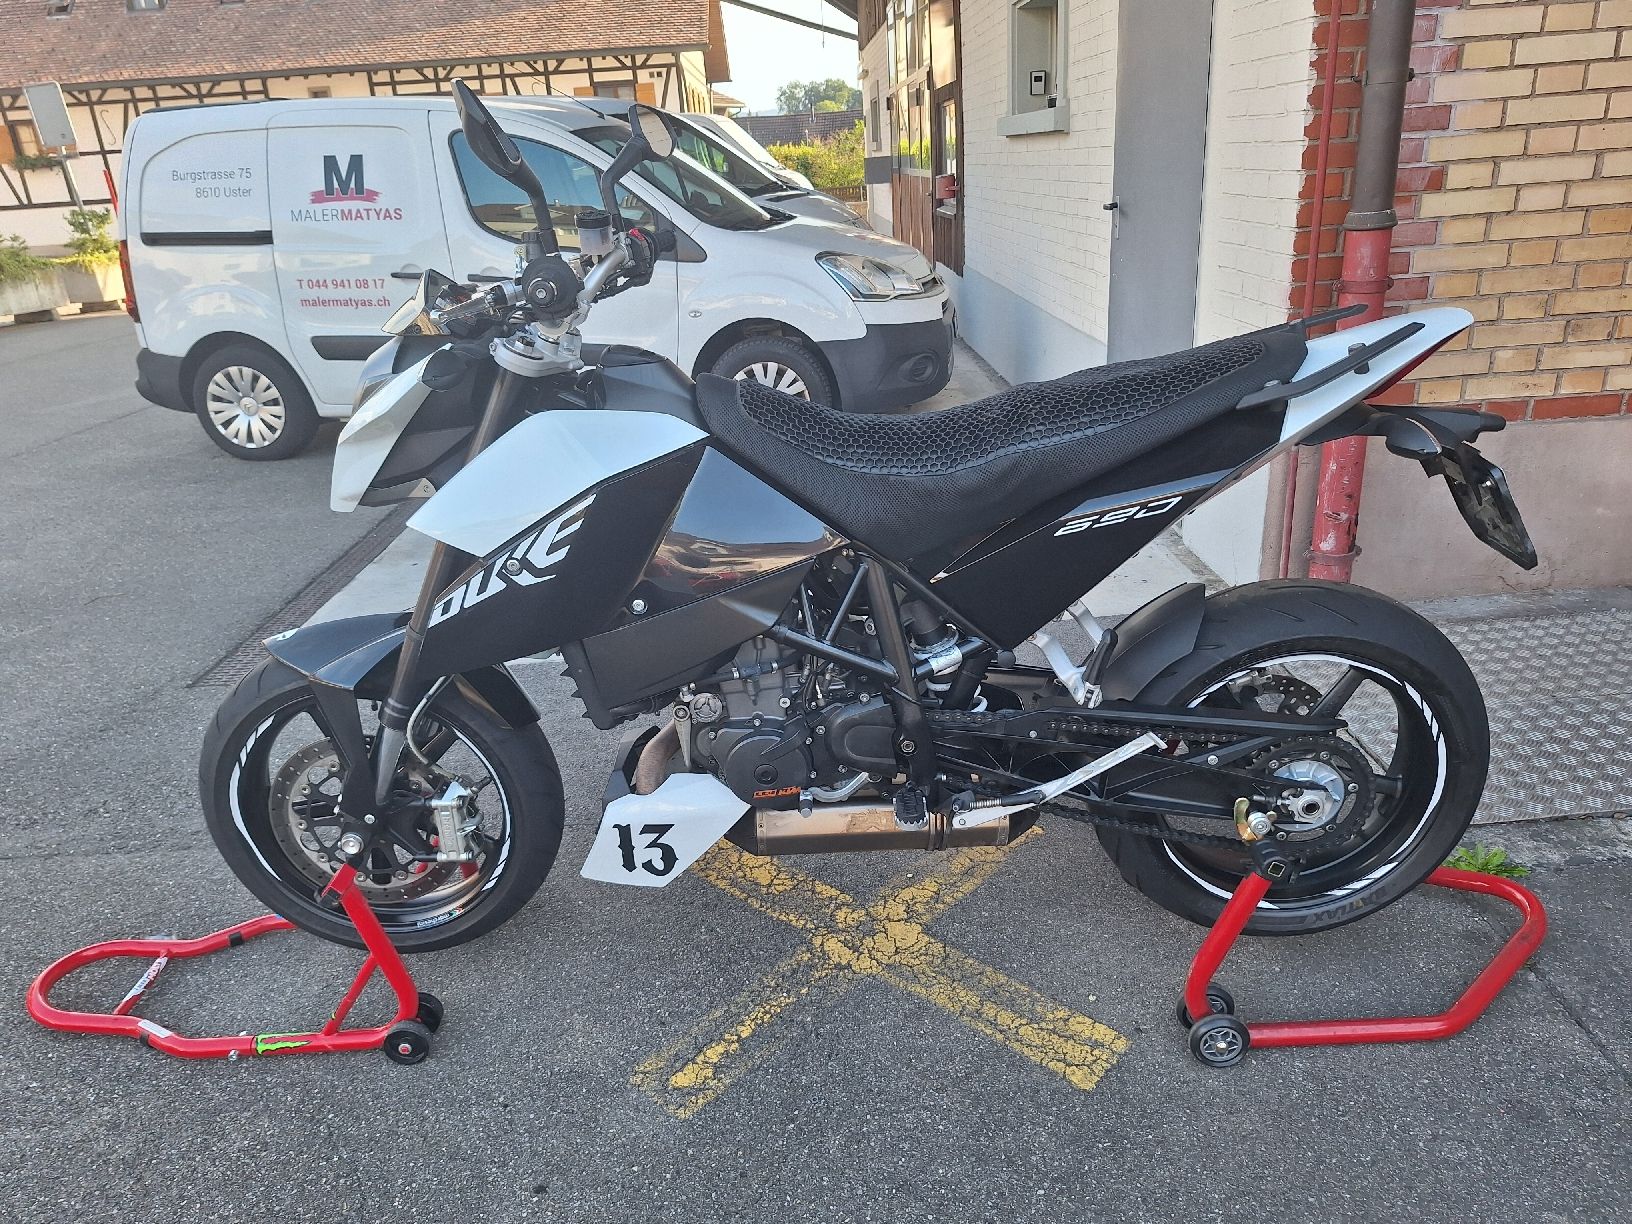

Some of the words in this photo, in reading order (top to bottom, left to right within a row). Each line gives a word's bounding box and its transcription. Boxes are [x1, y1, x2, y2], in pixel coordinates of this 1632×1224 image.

[172, 168, 236, 184] Burgstrasse
[237, 167, 252, 179] 75
[323, 154, 365, 196] M
[195, 186, 221, 199] 8610
[223, 186, 252, 198] Uster
[290, 207, 403, 222] MALERMATYAS
[297, 279, 304, 290] T
[307, 279, 328, 290] 044
[331, 279, 352, 290] 941
[355, 279, 369, 290] 08
[371, 278, 385, 289] 17
[300, 295, 391, 310] malermatyas.ch
[1053, 495, 1183, 537] 690
[427, 493, 597, 629] DUKE
[611, 823, 680, 877] 13
